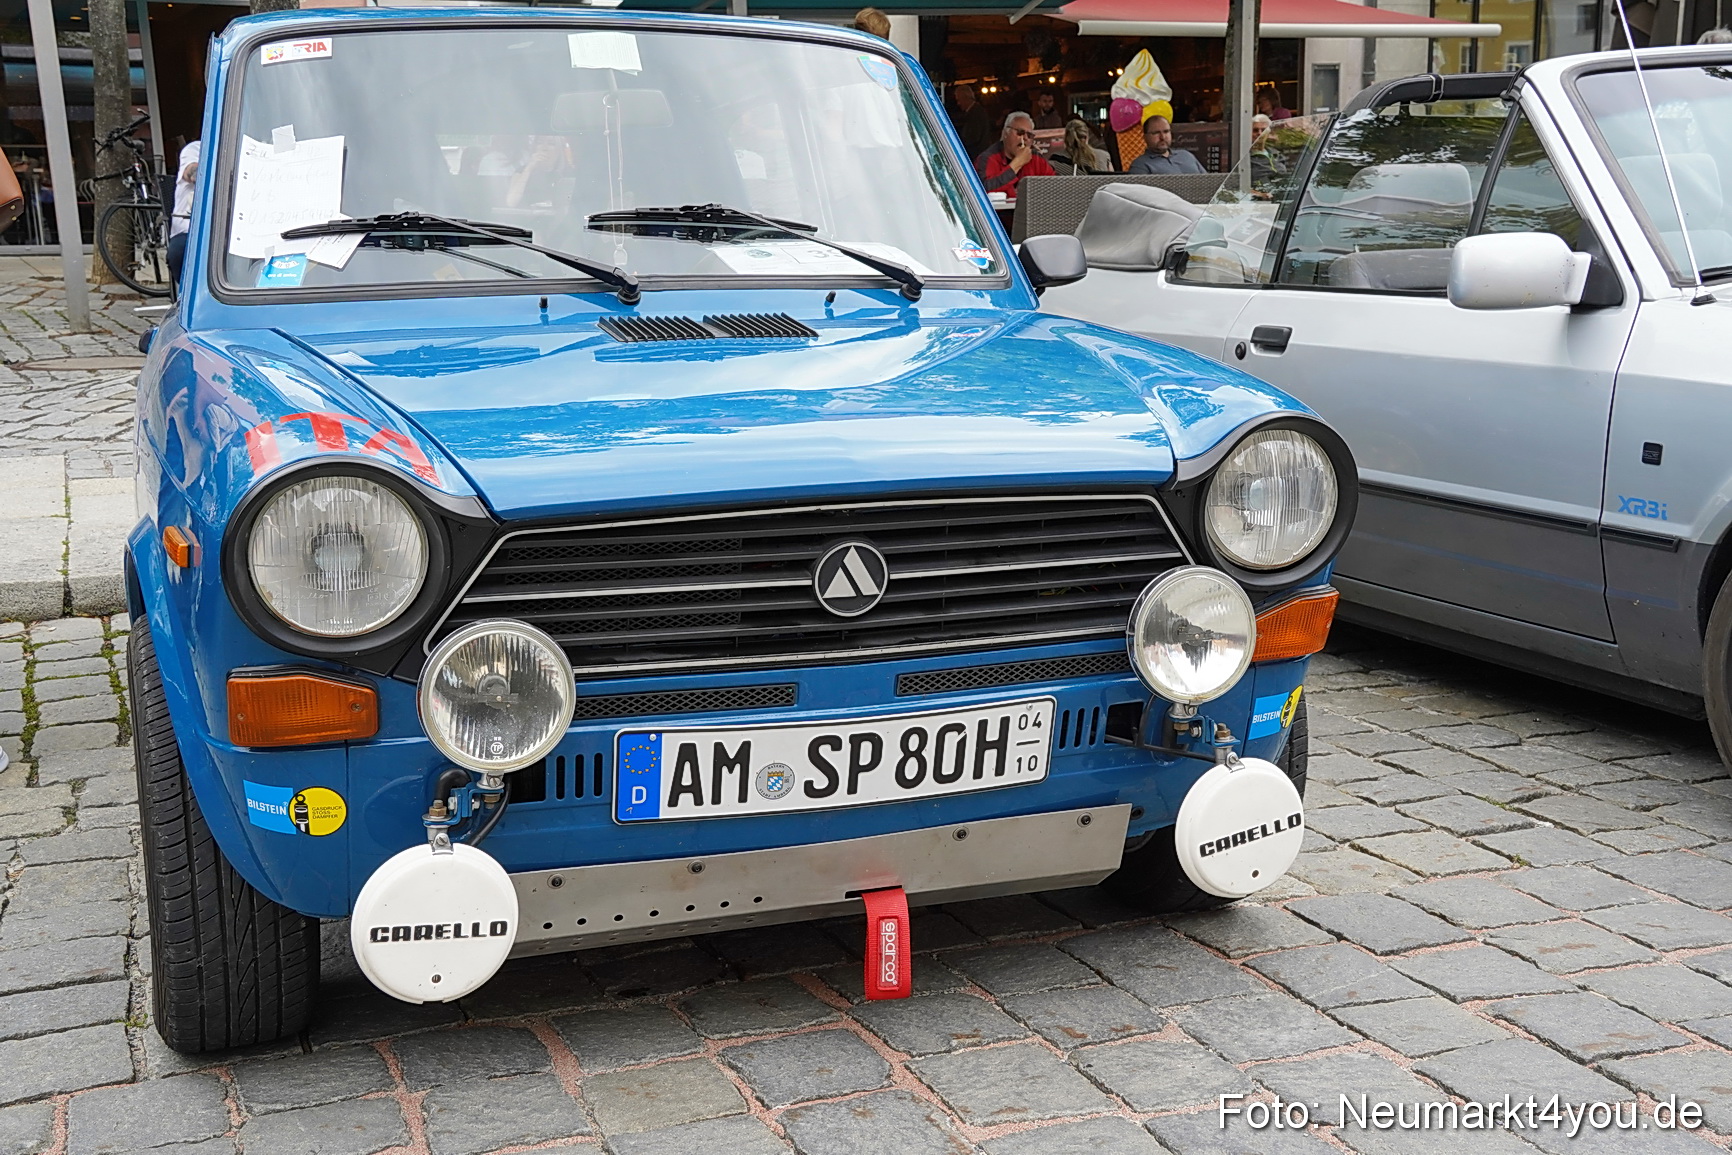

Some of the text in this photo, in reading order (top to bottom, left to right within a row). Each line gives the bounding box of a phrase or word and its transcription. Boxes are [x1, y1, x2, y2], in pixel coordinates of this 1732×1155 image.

[1618, 495, 1668, 520] XR3i
[1017, 711, 1042, 731] 04
[1252, 709, 1281, 724] BILSTEIN
[667, 715, 1011, 807] AM SP 80H
[1016, 754, 1039, 774] 10
[631, 786, 647, 805] D
[246, 798, 287, 816] BILSTEIN
[1200, 812, 1302, 858] CARELLO
[370, 920, 508, 944] CARELLO
[881, 922, 896, 983] sparco
